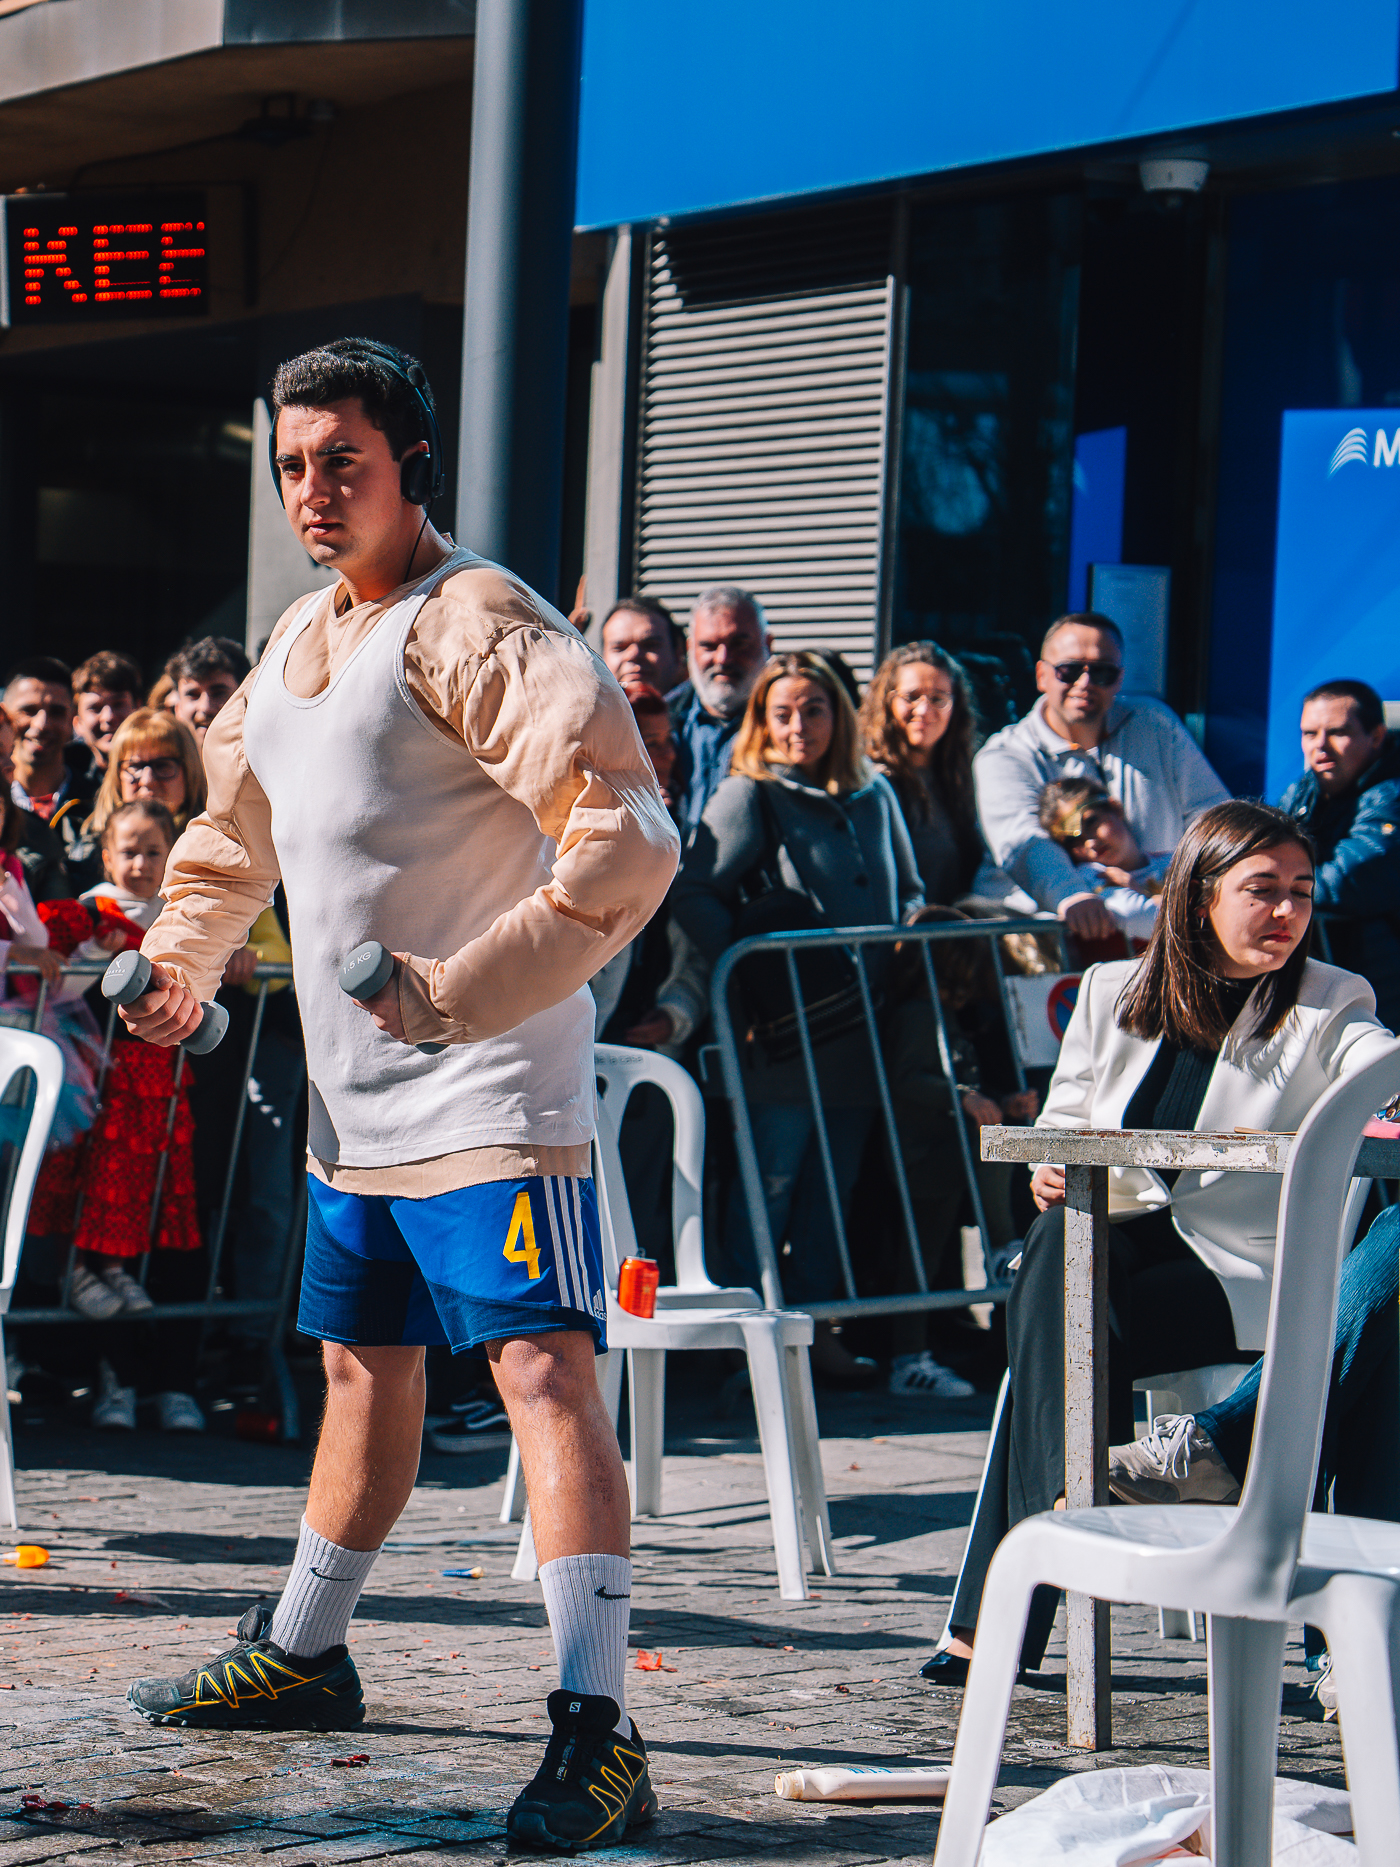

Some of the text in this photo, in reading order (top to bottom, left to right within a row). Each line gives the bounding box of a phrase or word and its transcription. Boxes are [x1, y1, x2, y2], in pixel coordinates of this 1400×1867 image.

[343, 951, 372, 975] 1.5 KG
[503, 1191, 541, 1280] 4
